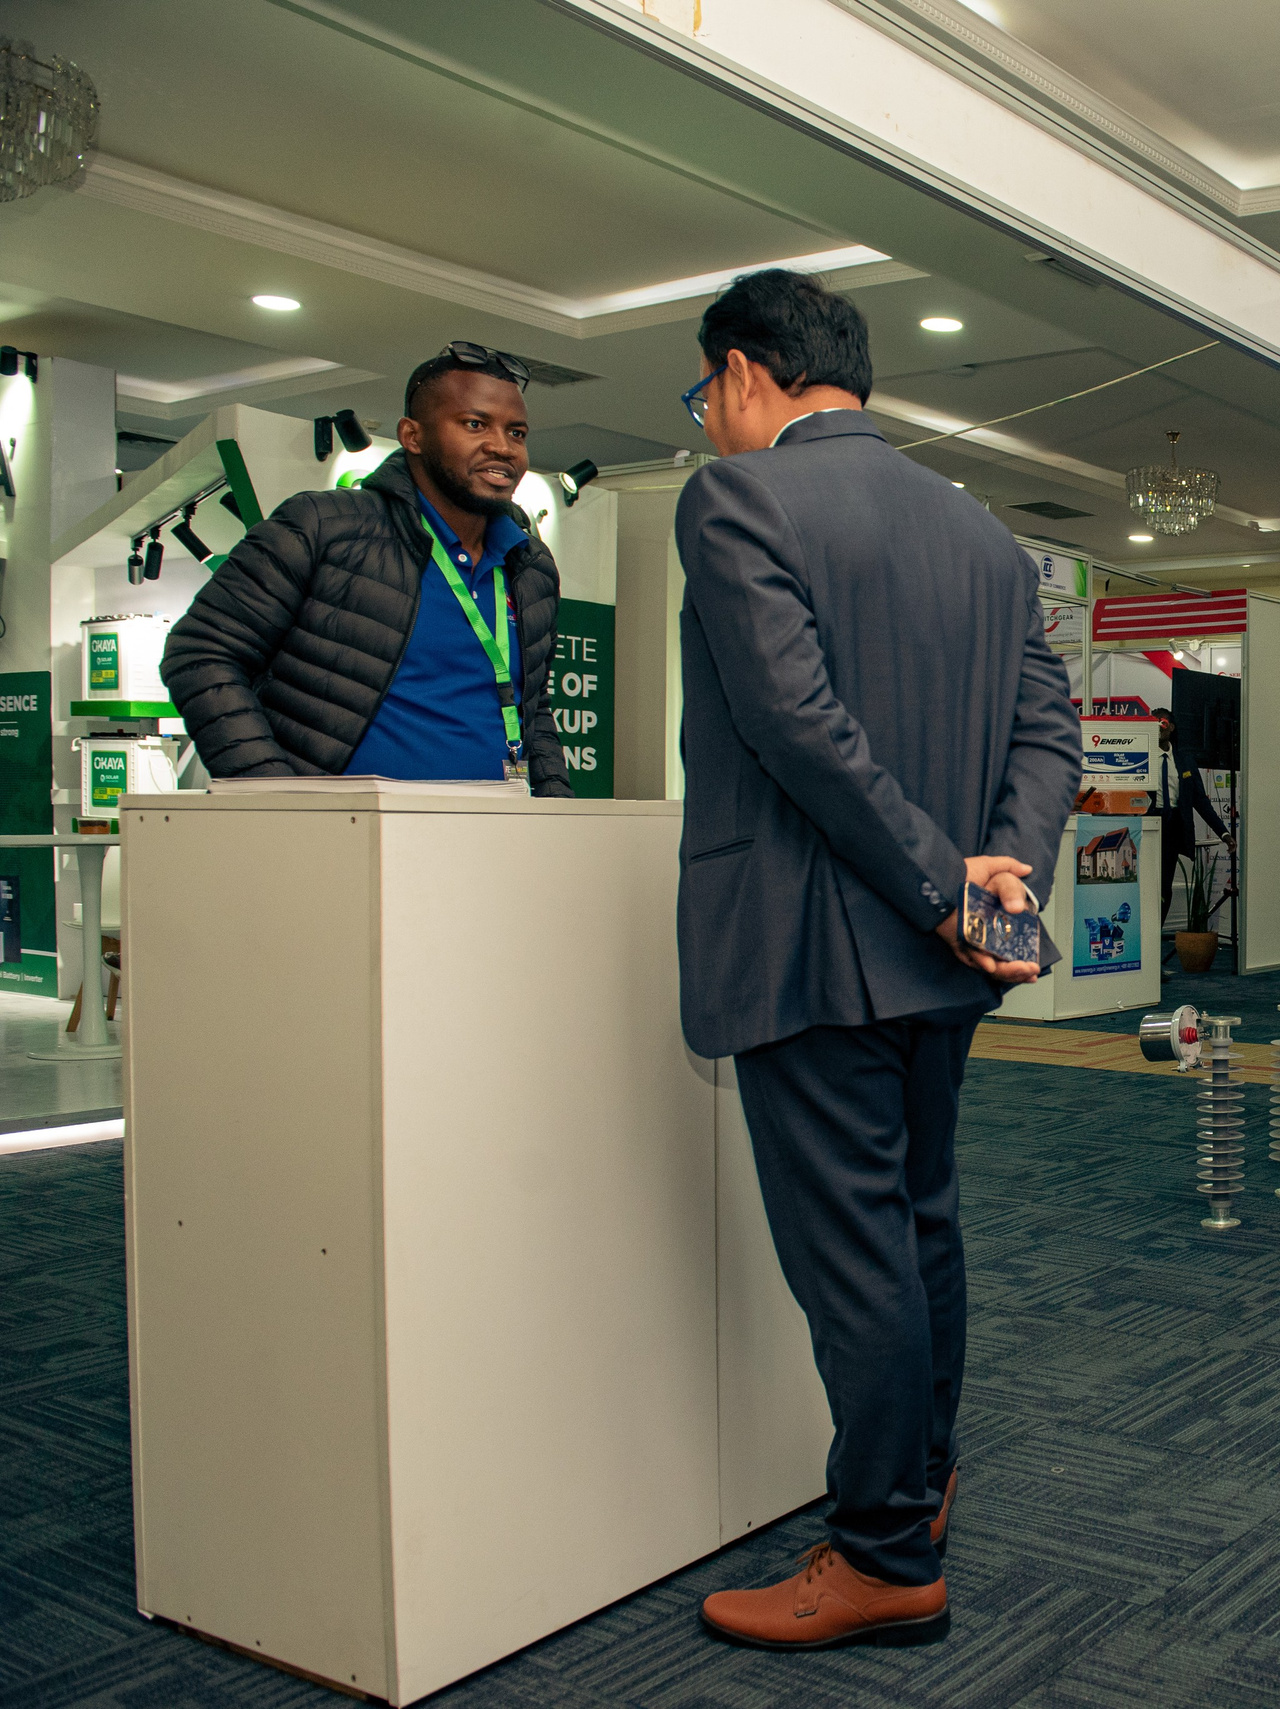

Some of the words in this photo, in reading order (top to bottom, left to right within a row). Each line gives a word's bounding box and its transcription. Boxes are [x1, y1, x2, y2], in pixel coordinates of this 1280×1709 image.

[1044, 614, 1074, 622] ITCHGEAR
[91, 639, 118, 653] OKAYA
[562, 672, 598, 698] OF
[94, 756, 125, 770] OKAYA
[24, 973, 44, 983] Inverter
